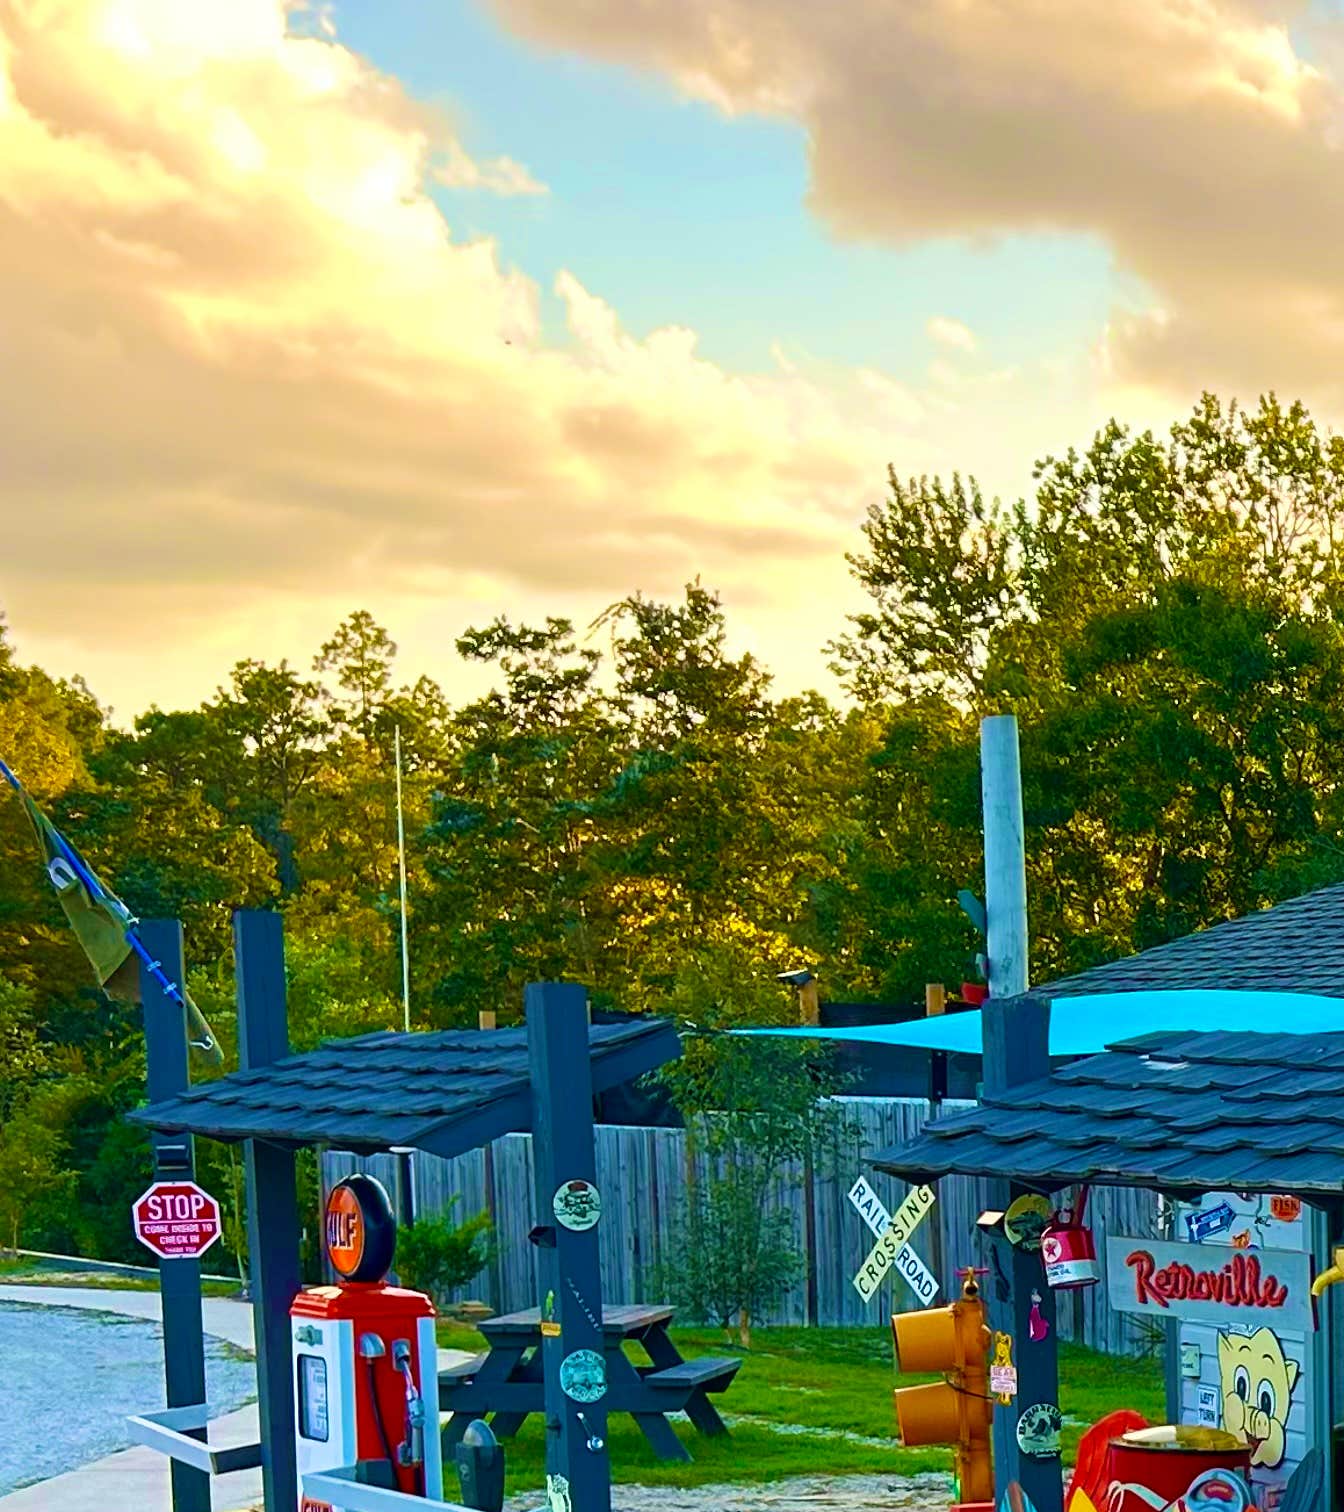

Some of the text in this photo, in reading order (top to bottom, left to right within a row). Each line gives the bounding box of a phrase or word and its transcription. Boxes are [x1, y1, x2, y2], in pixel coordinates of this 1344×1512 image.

[147, 1194, 205, 1220] STOP
[852, 1184, 934, 1300] RAIL ROAD
[858, 1186, 930, 1295] CROSSING
[1126, 1250, 1288, 1309] Retroville
